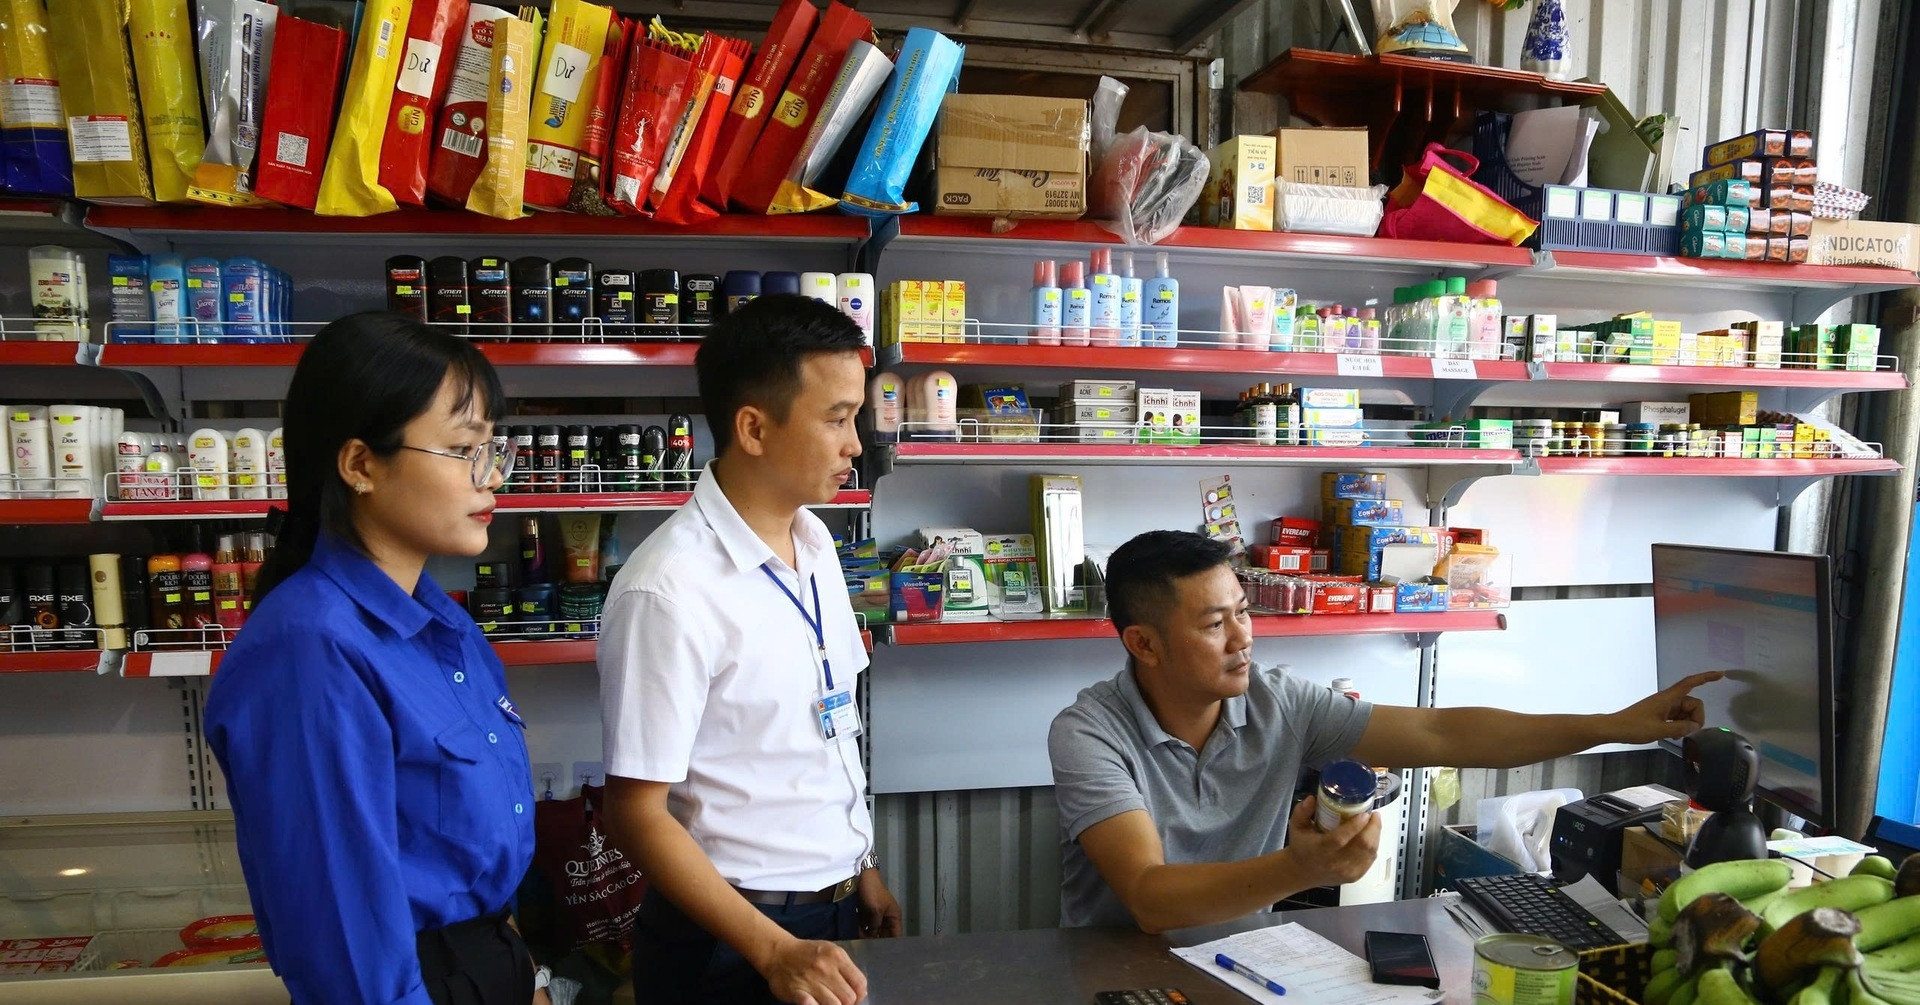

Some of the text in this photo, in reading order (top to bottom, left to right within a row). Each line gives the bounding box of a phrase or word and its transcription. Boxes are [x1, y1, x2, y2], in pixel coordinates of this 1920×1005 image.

[746, 89, 761, 108] GIN
[789, 98, 805, 120] GIN
[410, 109, 420, 126] GIN
[945, 195, 969, 203] PACK
[1044, 190, 1080, 200] MY 327919
[1044, 200, 1068, 208] 330087
[112, 286, 144, 296] Gillette
[157, 299, 175, 310] Secret
[196, 299, 216, 310] Secret
[1143, 395, 1169, 405] ichnhi
[1644, 406, 1686, 414] Phosphalugel
[607, 880, 626, 893] CAO
